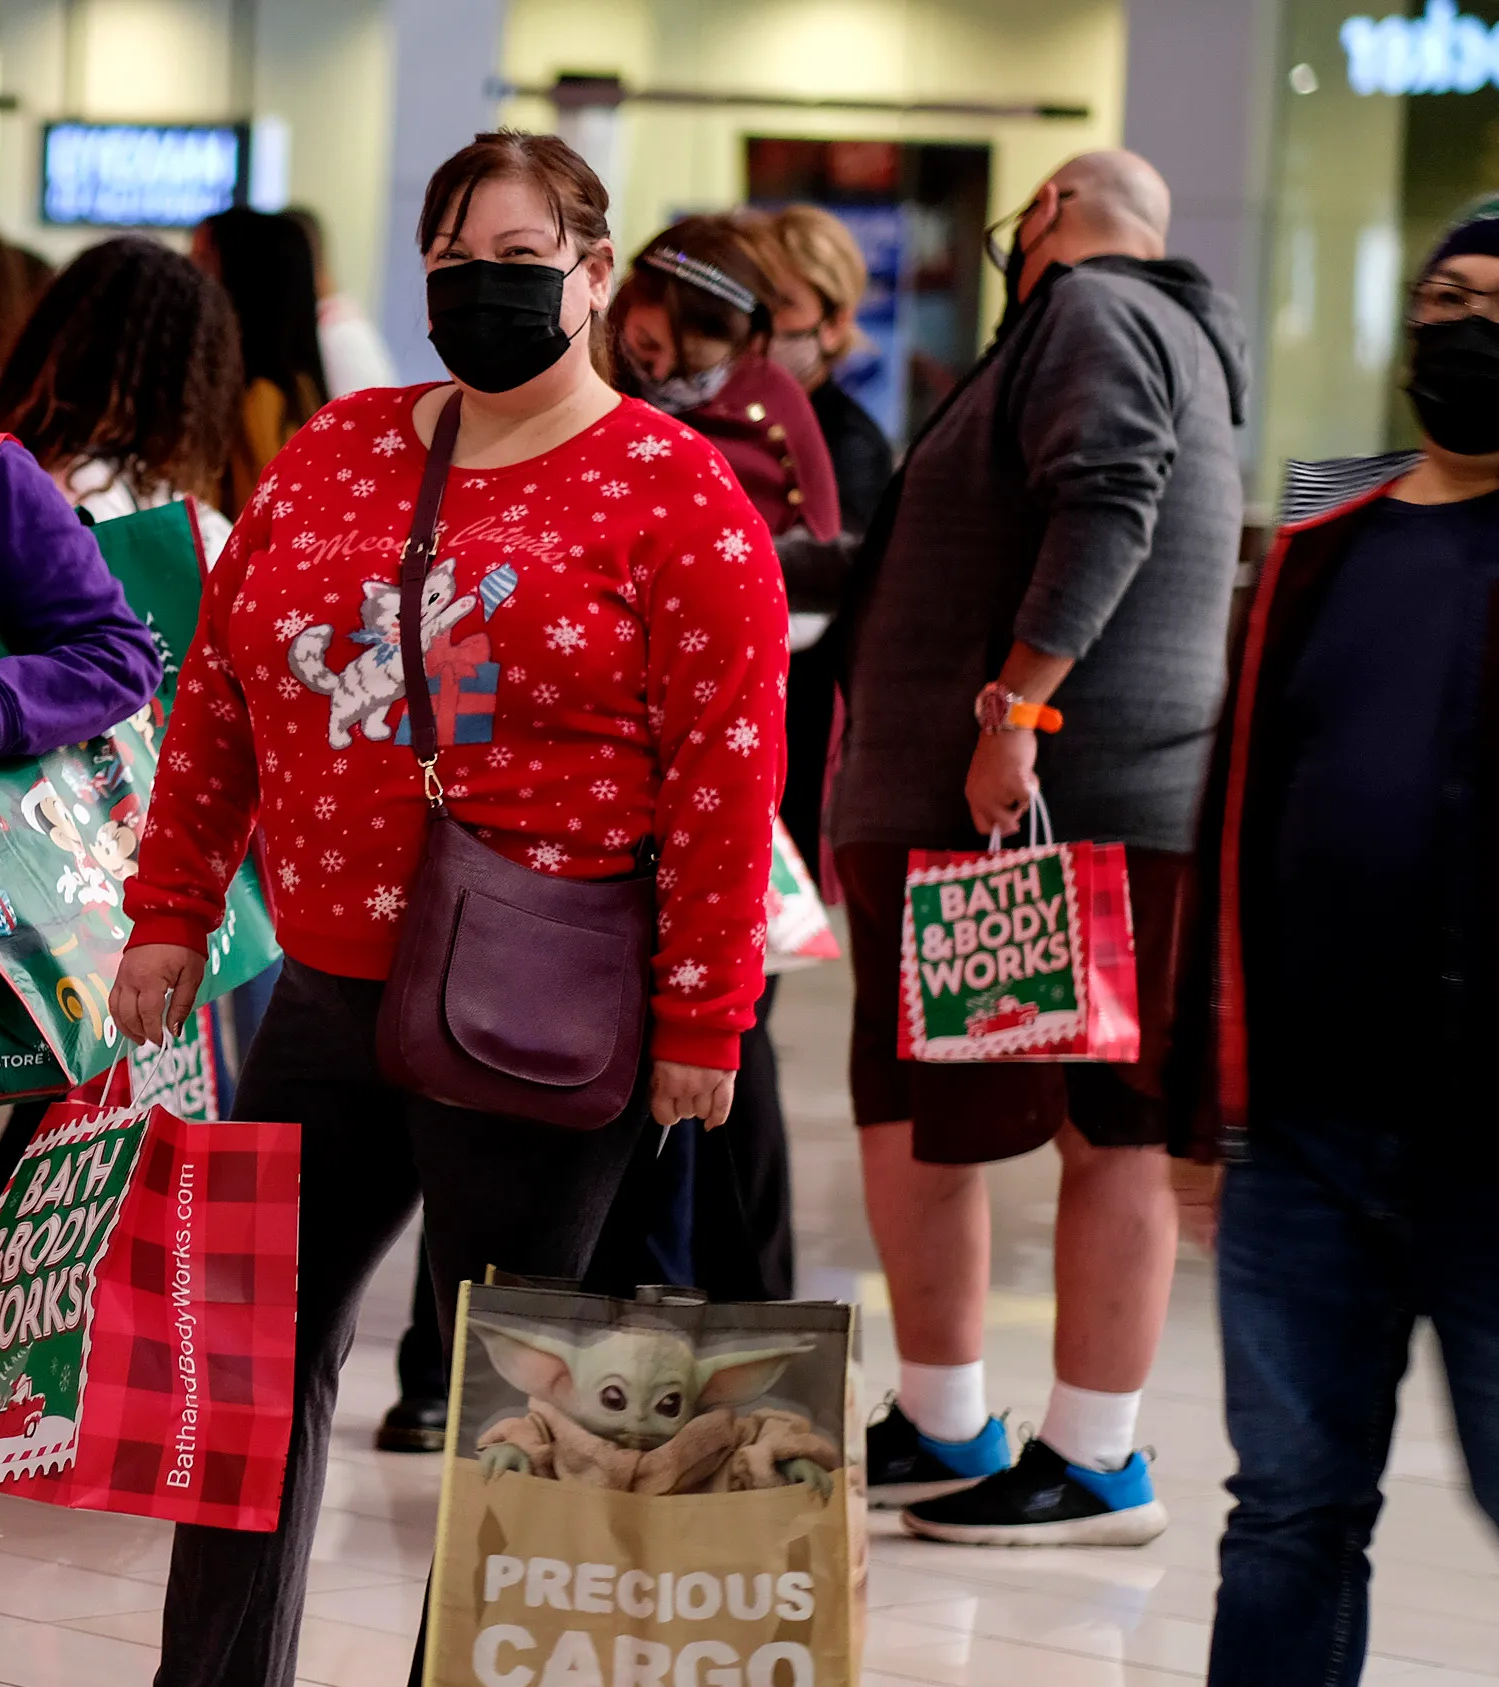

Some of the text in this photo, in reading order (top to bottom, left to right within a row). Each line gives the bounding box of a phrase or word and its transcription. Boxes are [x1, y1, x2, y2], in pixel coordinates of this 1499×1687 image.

[305, 530, 405, 565] Meo
[939, 863, 1041, 922] BATH
[921, 932, 1070, 998] WORKS
[15, 1137, 126, 1219] BATH
[166, 1163, 195, 1489] BathandBodyWorks.com
[483, 1554, 815, 1624] PRECIOUS
[472, 1623, 815, 1687] CARGO
